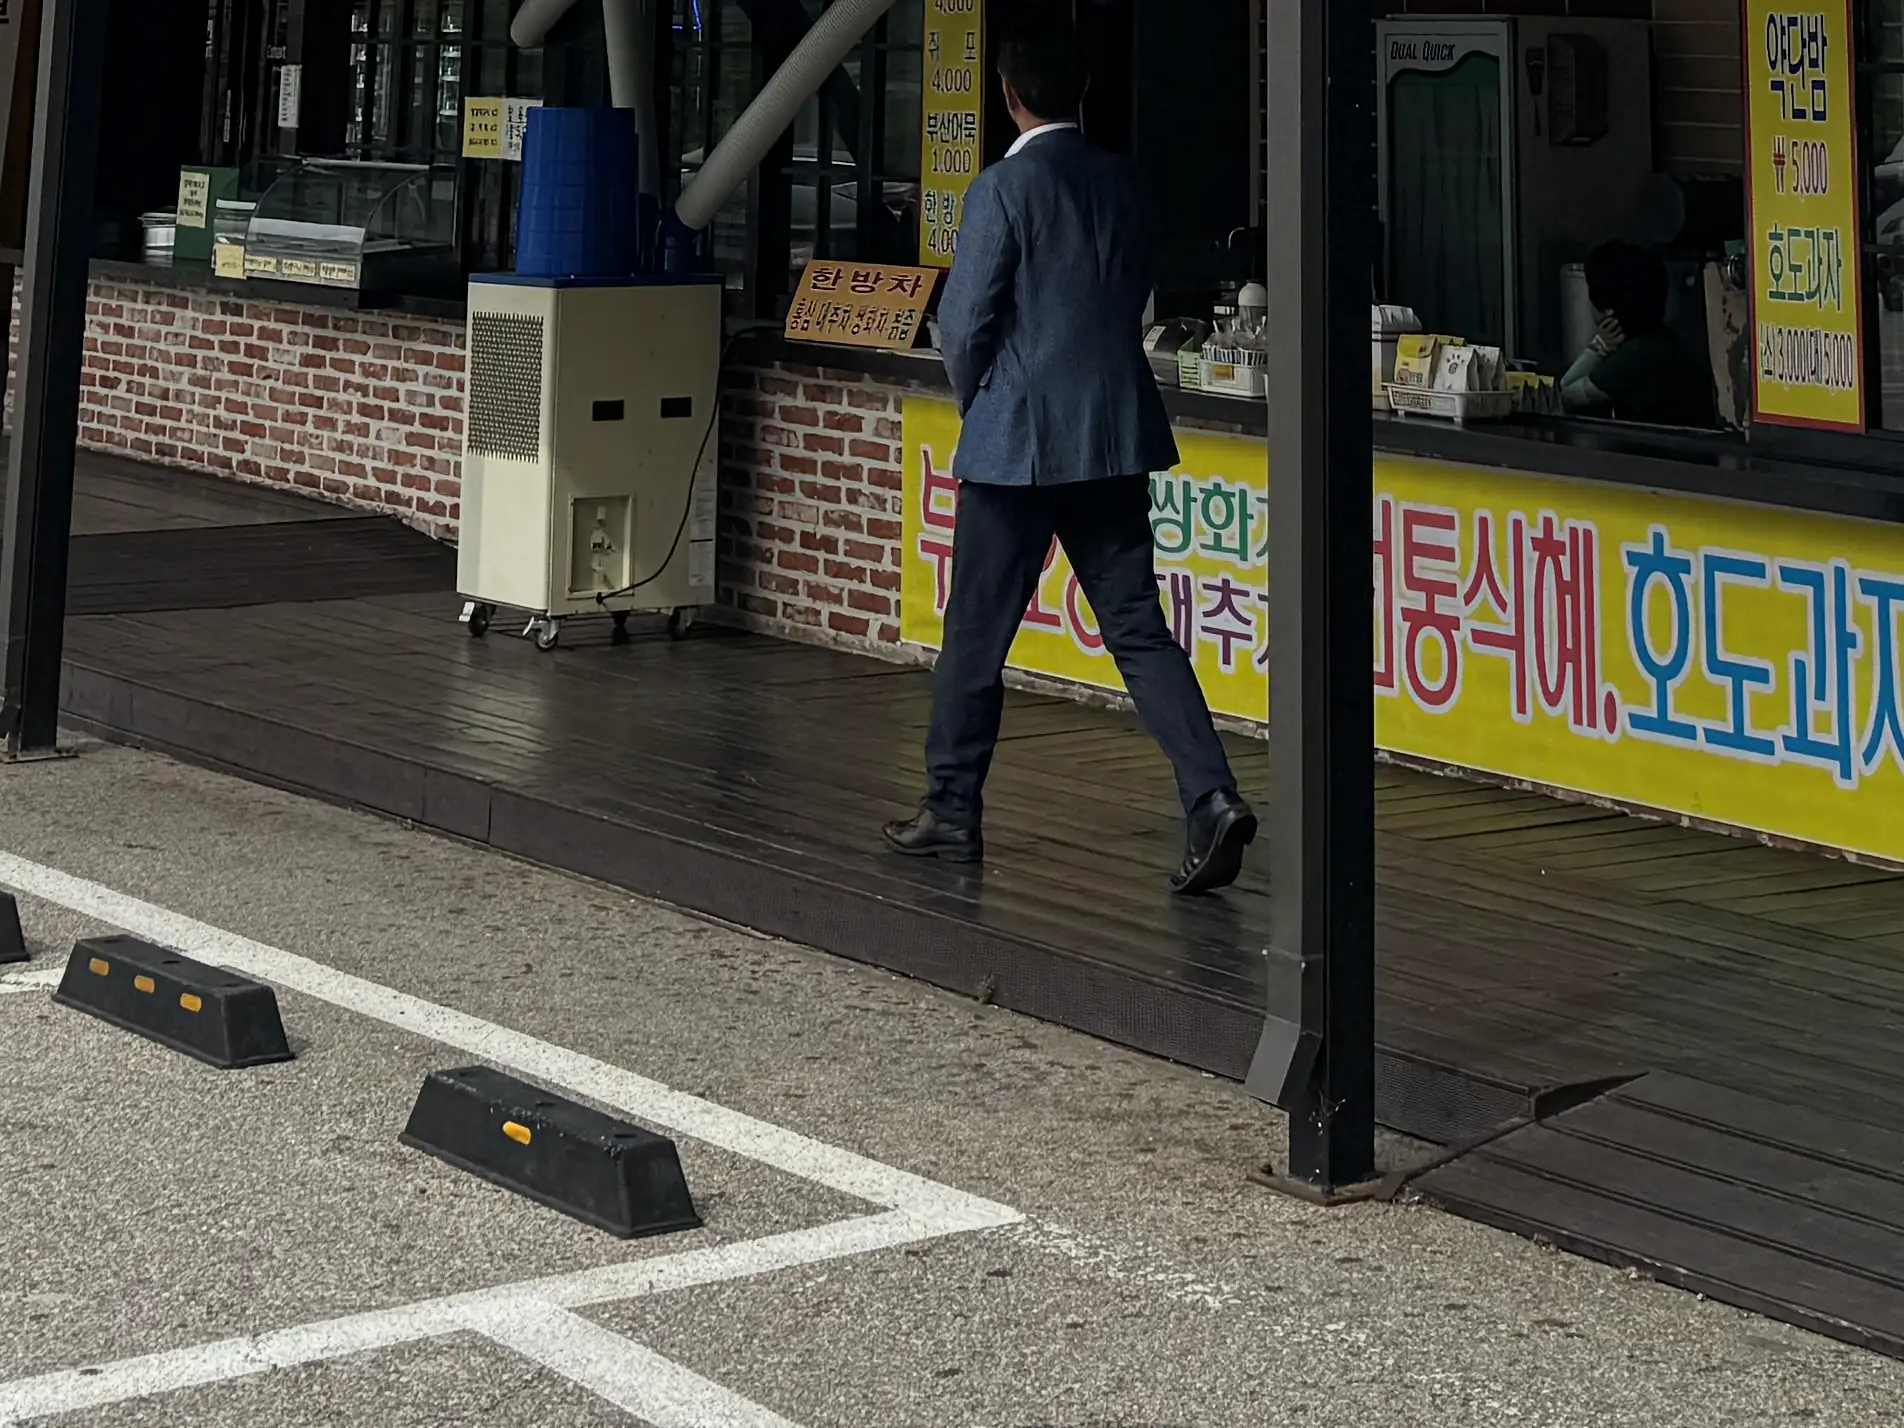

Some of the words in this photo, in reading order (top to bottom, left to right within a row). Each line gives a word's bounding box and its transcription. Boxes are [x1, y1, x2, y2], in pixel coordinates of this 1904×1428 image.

[1390, 40, 1418, 60] DUAL
[1422, 40, 1456, 62] QUICK
[1765, 12, 1828, 122] 약단밤
[926, 112, 977, 145] 부산어묵
[924, 190, 966, 226] 한방
[1767, 223, 1843, 312] 호도과자
